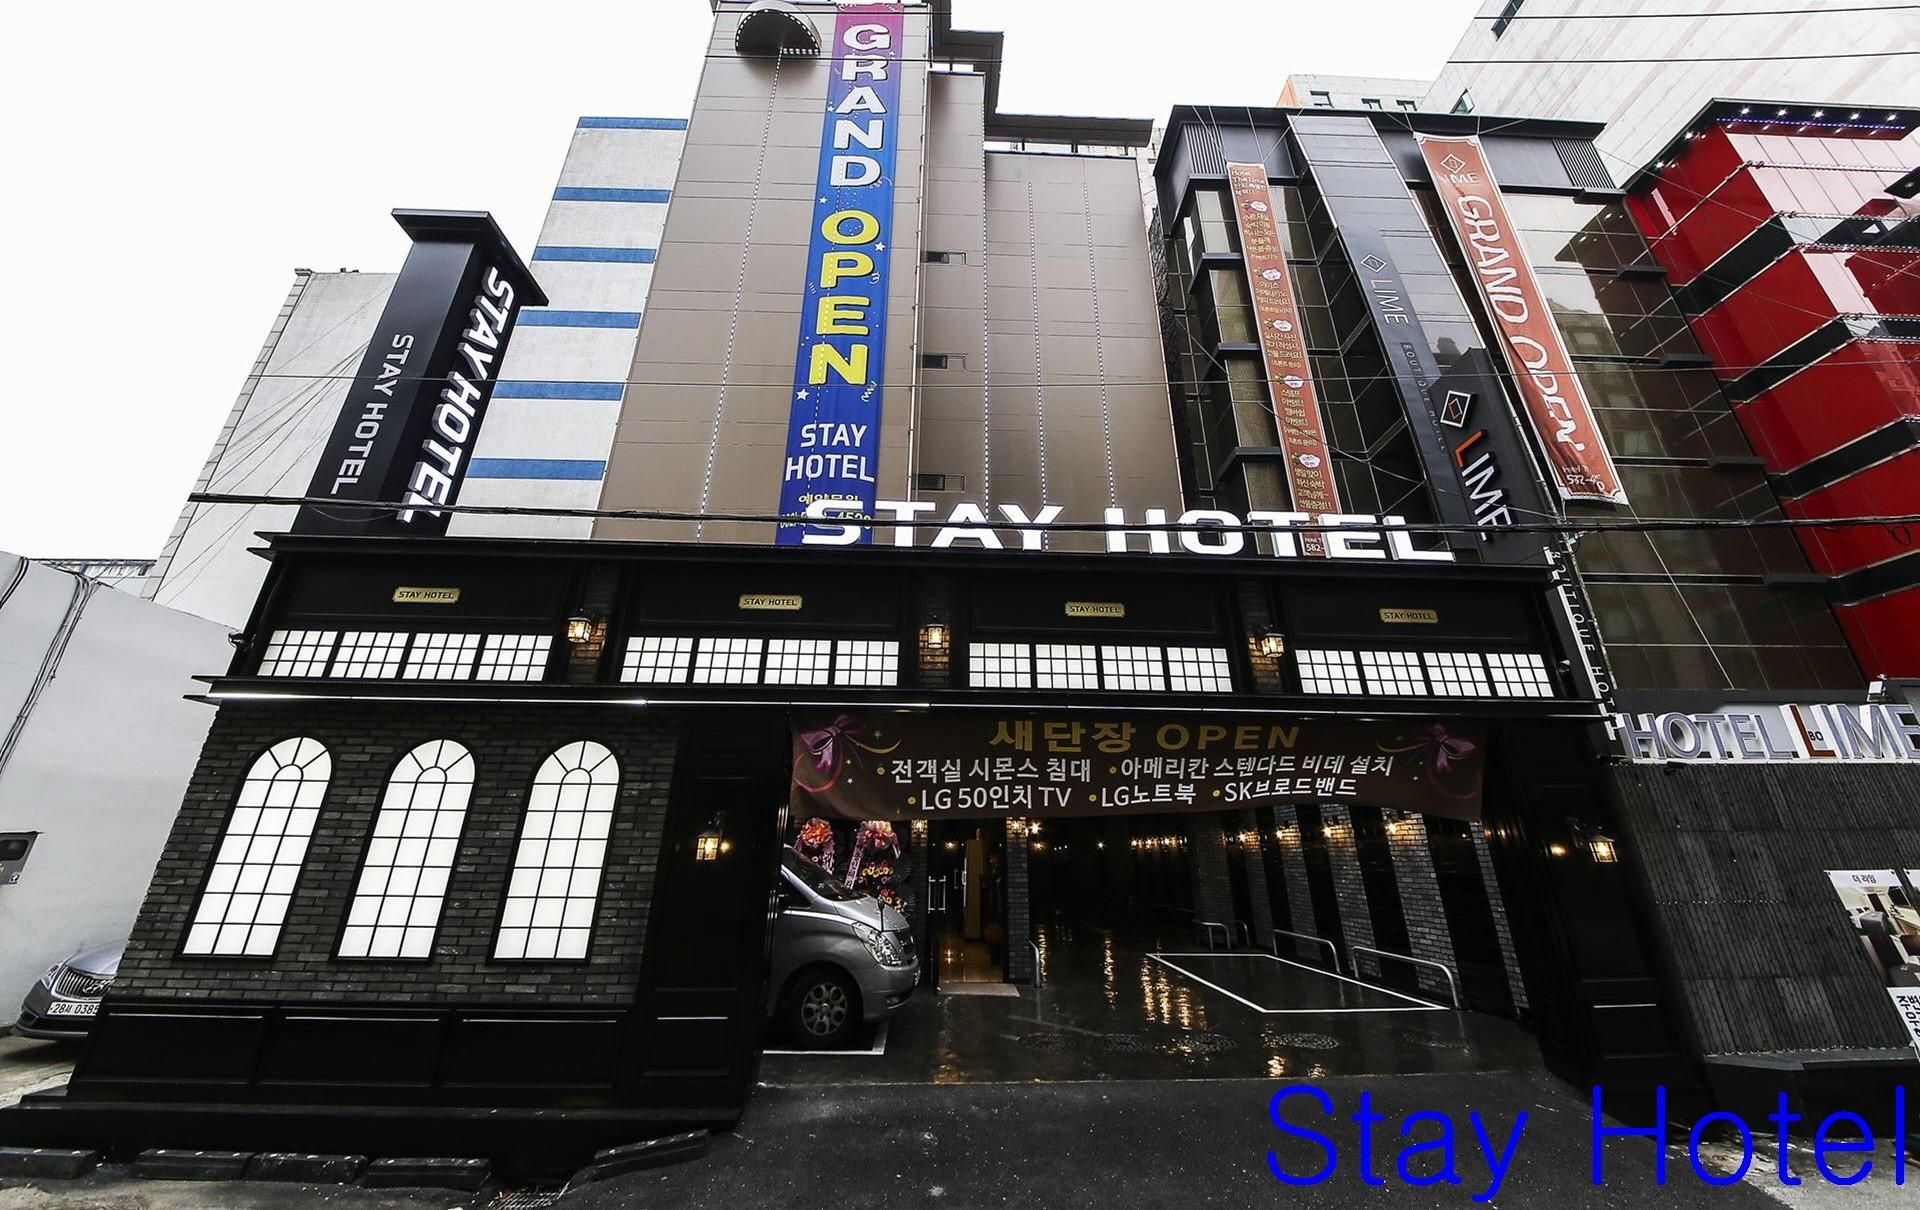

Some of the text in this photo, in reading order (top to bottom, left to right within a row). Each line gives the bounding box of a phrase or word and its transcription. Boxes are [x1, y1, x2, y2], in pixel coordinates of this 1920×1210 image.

[808, 23, 891, 386] GRAND OPEN
[1370, 278, 1409, 326] LIME
[1458, 195, 1585, 452] GRAND OPEN
[396, 266, 515, 523] STAY HOTEL
[330, 334, 415, 495] STAY HOTEL
[801, 423, 868, 448] STAY
[785, 454, 875, 483] HOTEL
[1455, 430, 1513, 542] LIME
[802, 500, 1455, 561] STAY HOTEL
[424, 591, 454, 599] HOTEL
[743, 598, 765, 606] STAY
[1070, 605, 1121, 614] STAY HOTEL
[1384, 611, 1433, 620] STAY HOTEL
[989, 720, 1300, 753] 새단장 OPEN
[1615, 703, 1920, 761] HOTEL LIME
[891, 757, 1091, 784] 전객실 시몬스 침대
[1121, 754, 1394, 780] 아메리칸 스텐다드 비데 설치
[921, 785, 1072, 810] LG 50인치 TV
[1101, 783, 1197, 807] LG노트북
[1224, 777, 1358, 802] SK브로드밴드
